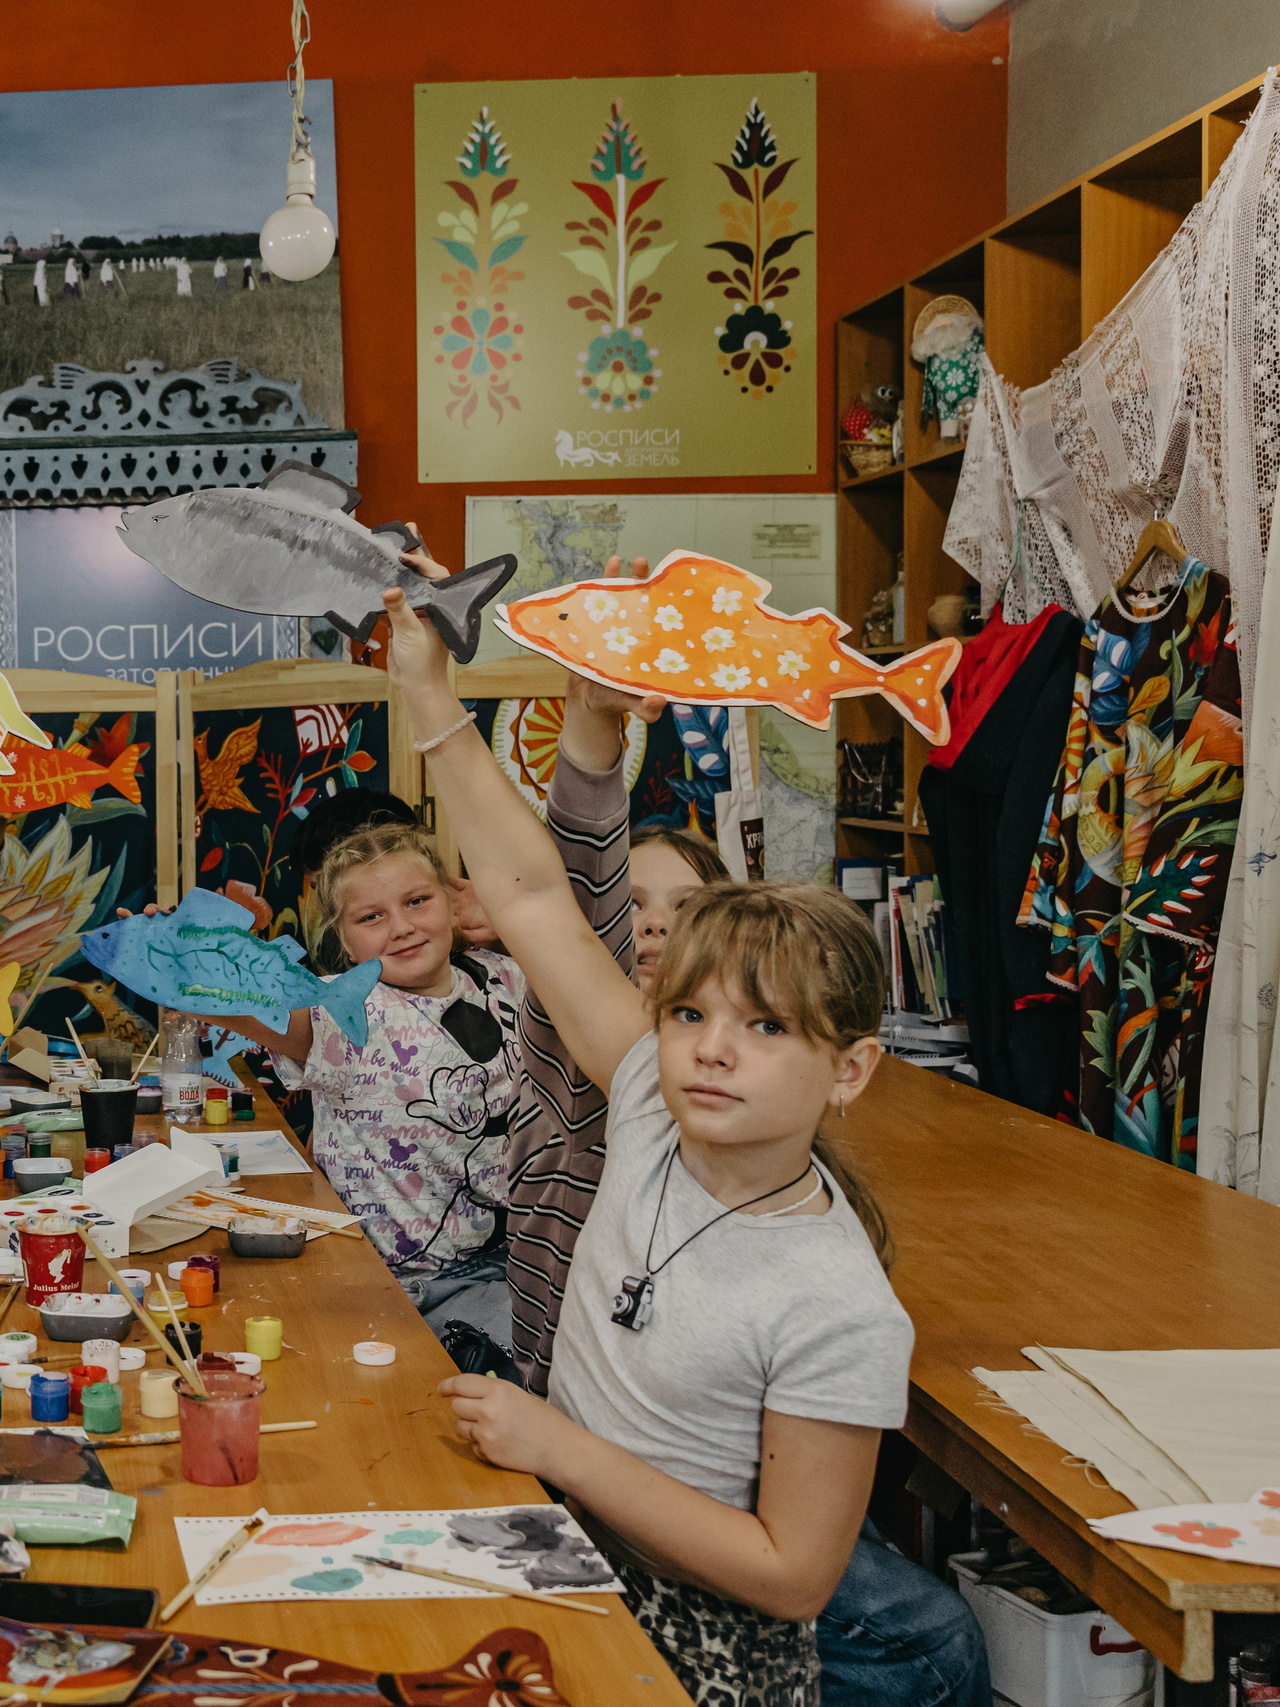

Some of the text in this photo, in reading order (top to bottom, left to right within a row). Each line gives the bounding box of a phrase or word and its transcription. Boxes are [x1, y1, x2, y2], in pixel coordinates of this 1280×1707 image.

[576, 428, 680, 447] РОСПИСИ
[624, 453, 680, 467] ЗЕМЕЛЬ
[33, 621, 263, 662] РОСПИСИ
[371, 1049, 386, 1067] be
[179, 1089, 200, 1101] ВОДА
[381, 1158, 420, 1172] mine
[32, 1284, 58, 1292] Julius
